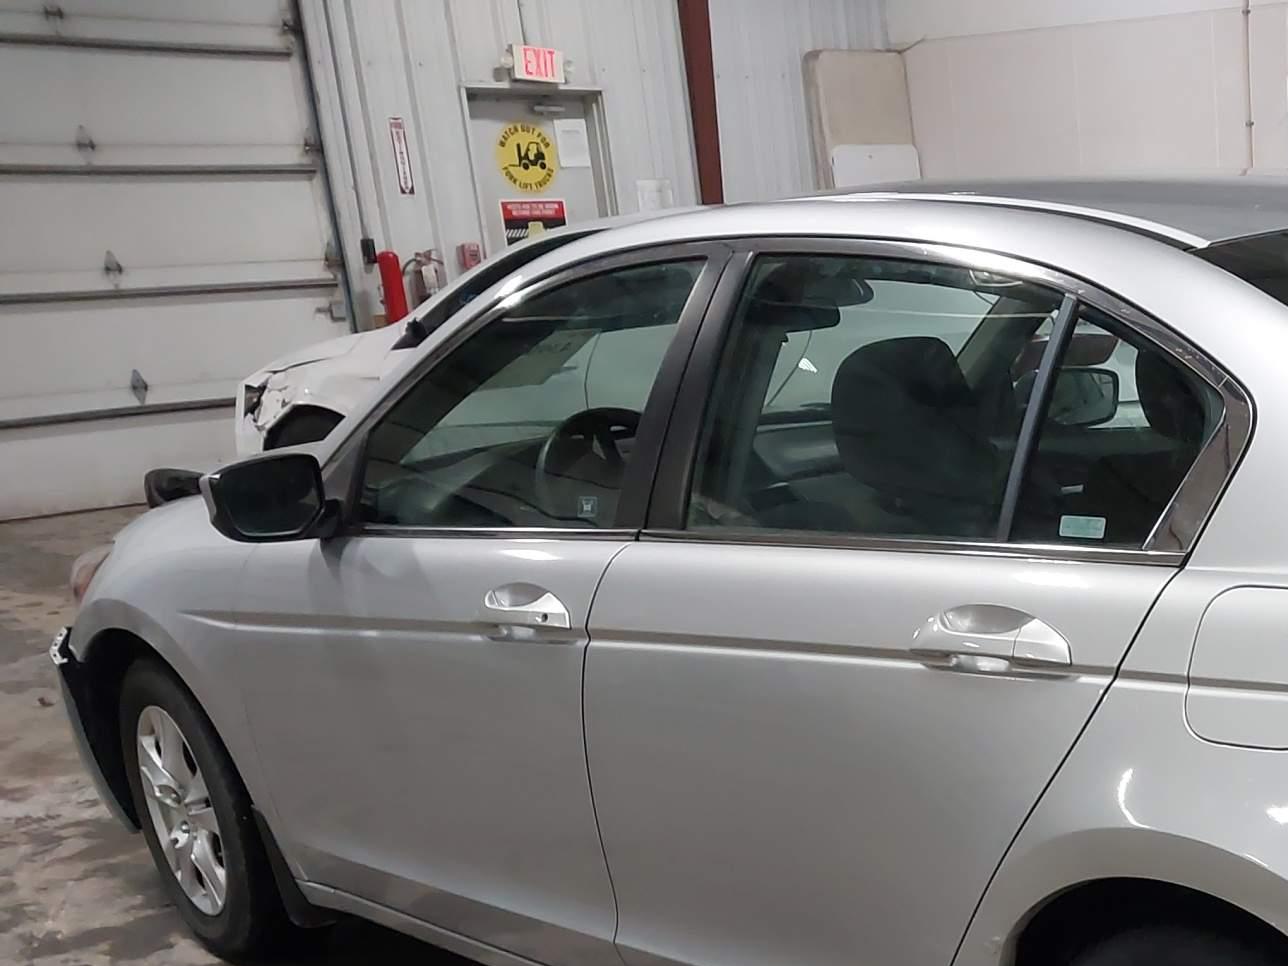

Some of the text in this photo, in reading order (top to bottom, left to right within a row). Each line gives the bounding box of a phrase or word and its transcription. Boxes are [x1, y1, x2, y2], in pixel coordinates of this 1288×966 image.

[523, 48, 555, 78] EXIT
[499, 124, 551, 148] WATCH OUT FOR
[502, 166, 555, 191] FORK LIFT TRUCKS
